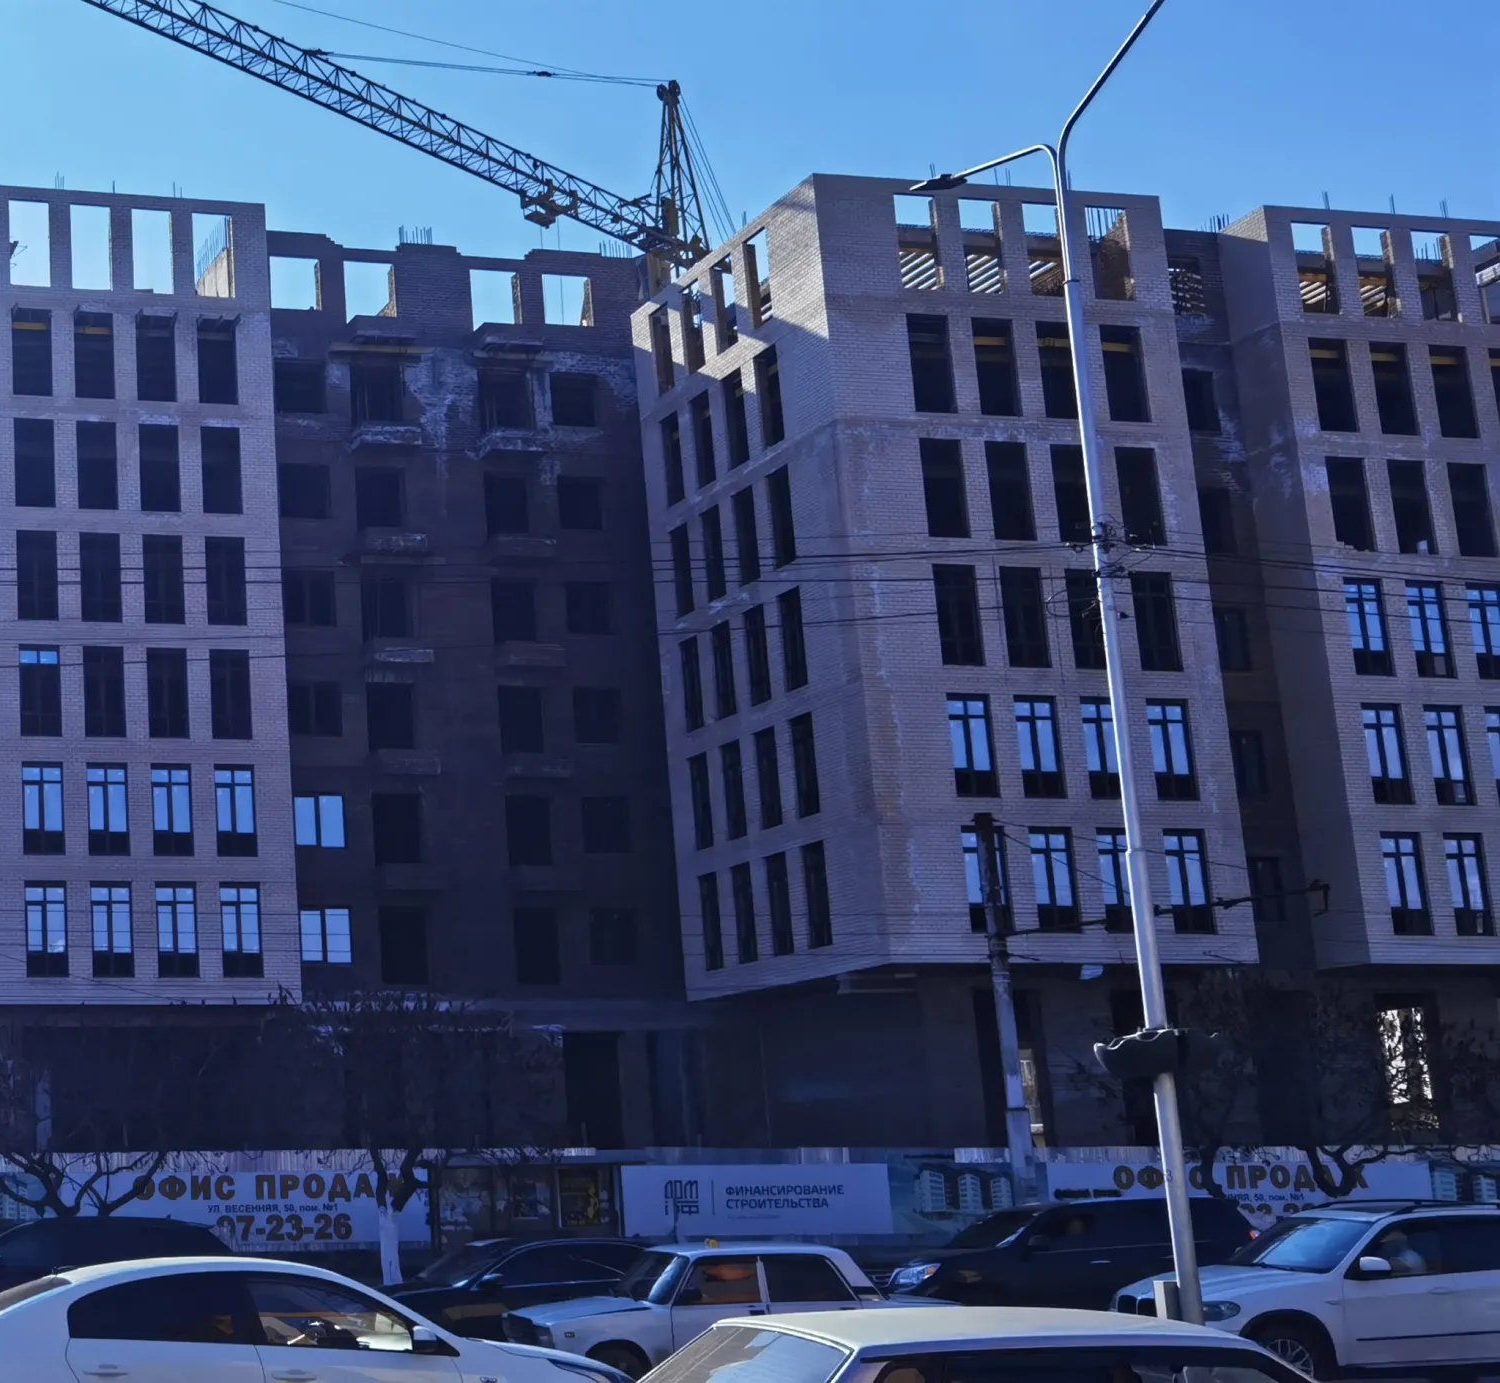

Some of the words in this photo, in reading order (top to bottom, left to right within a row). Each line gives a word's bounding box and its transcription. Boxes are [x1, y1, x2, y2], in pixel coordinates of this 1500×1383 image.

[664, 1179, 699, 1200] ДОМ
[725, 1185, 845, 1196] ФИНАНСИРОВАНИЕ
[726, 1199, 829, 1209] СТРОИТЕЛЬСТВА
